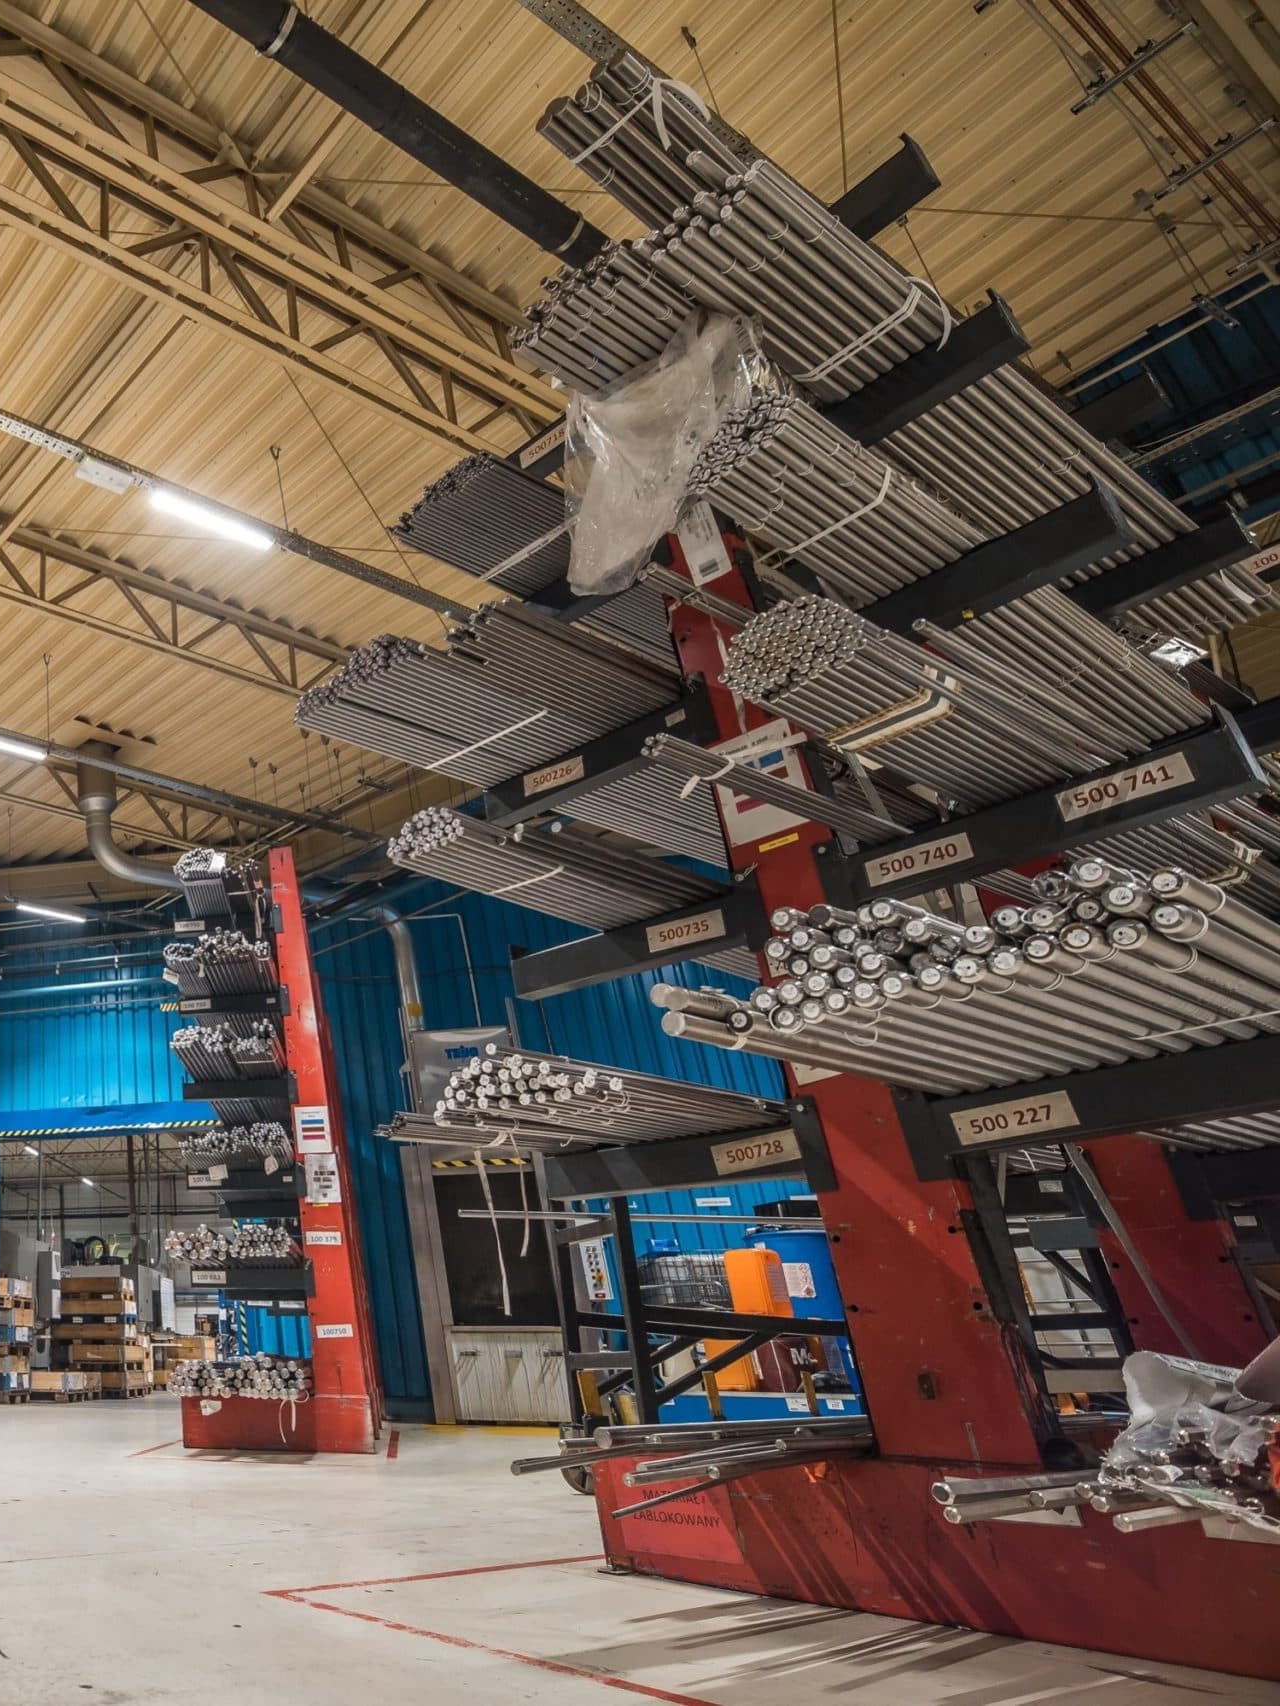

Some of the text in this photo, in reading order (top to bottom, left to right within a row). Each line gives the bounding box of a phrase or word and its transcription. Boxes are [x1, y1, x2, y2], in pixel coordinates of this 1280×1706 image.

[532, 764, 574, 788] 500226
[1073, 765, 1174, 808] 500 741
[878, 842, 958, 876] 500 740
[658, 919, 710, 943] 500735
[969, 1104, 1052, 1135] 500 227
[726, 1140, 784, 1164] 500728
[632, 1507, 721, 1529] ZABLOKOWANY
